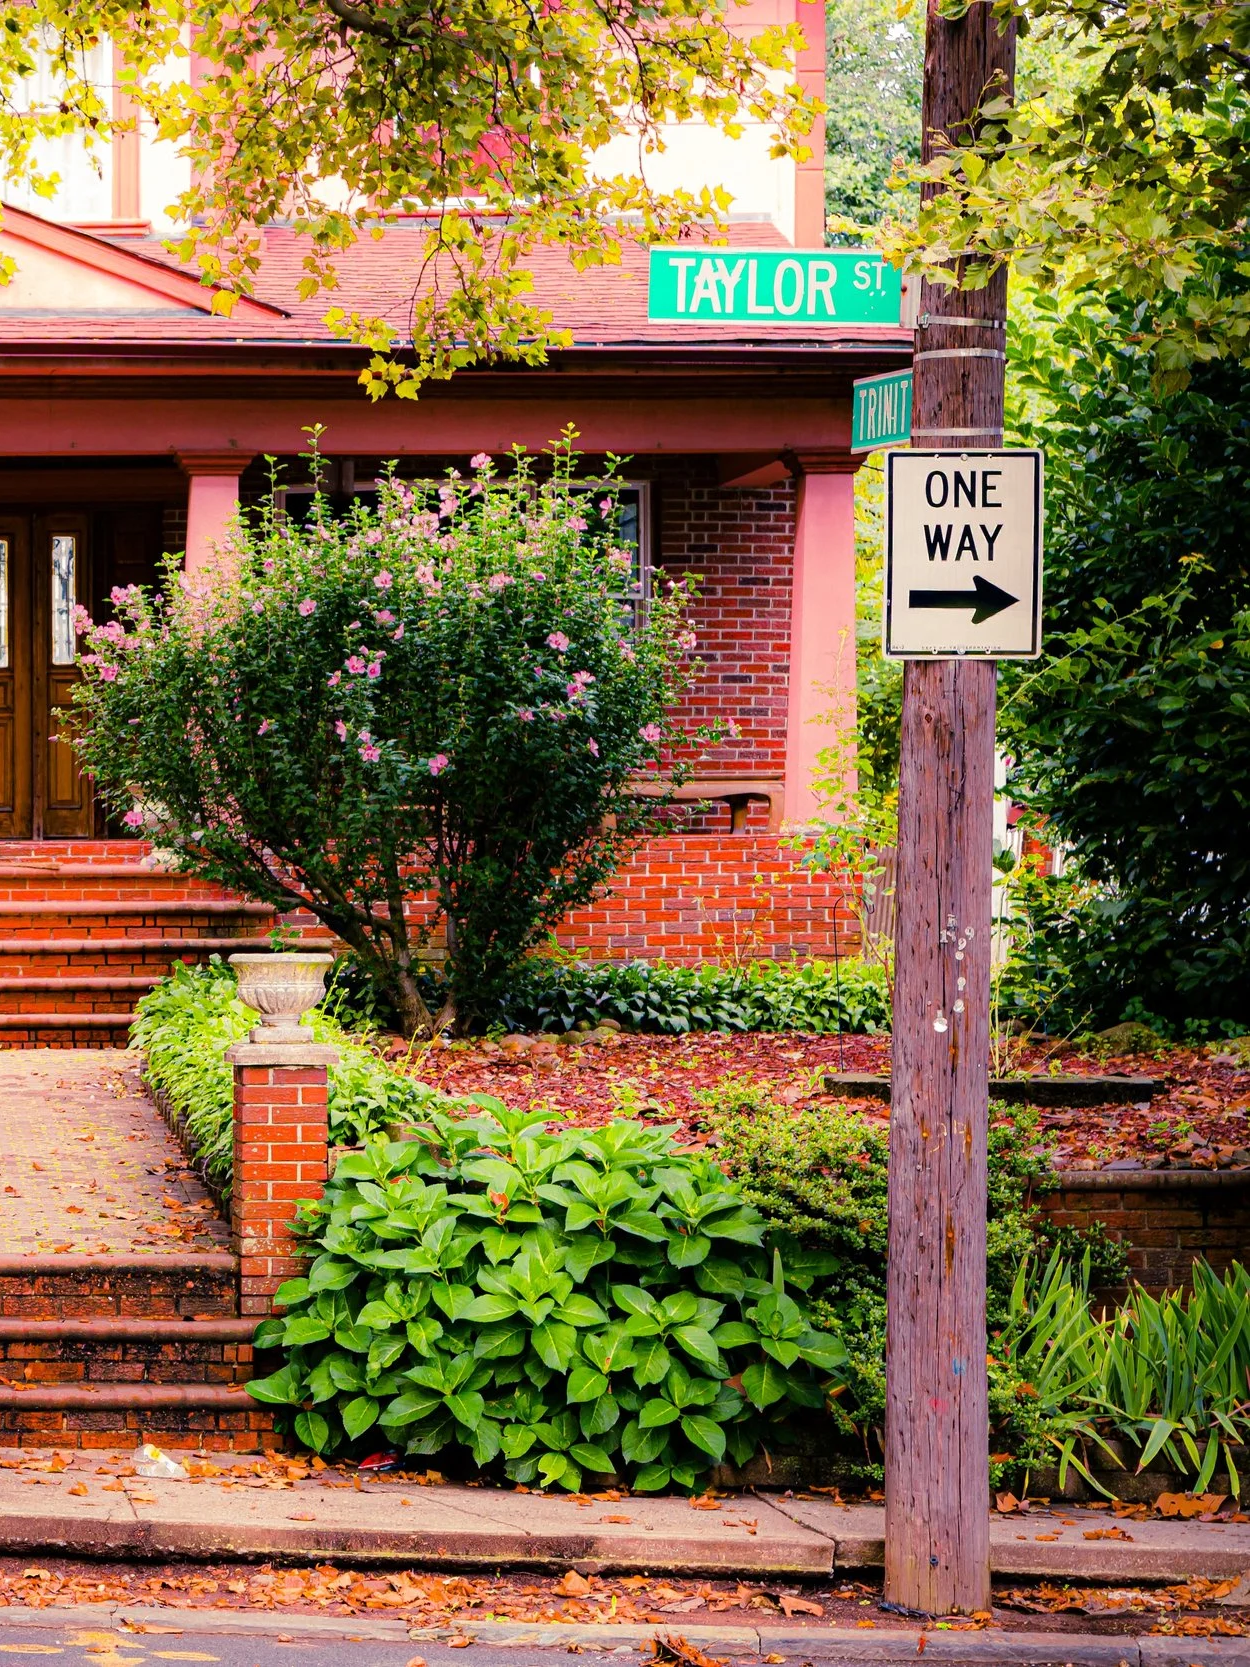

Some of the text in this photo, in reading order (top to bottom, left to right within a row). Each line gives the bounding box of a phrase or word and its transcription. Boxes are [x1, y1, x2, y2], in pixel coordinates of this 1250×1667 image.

[668, 257, 888, 316] TAYLOR ST
[859, 379, 913, 441] TRINIT
[925, 470, 1003, 508] ONE
[923, 524, 1004, 561] WAY
